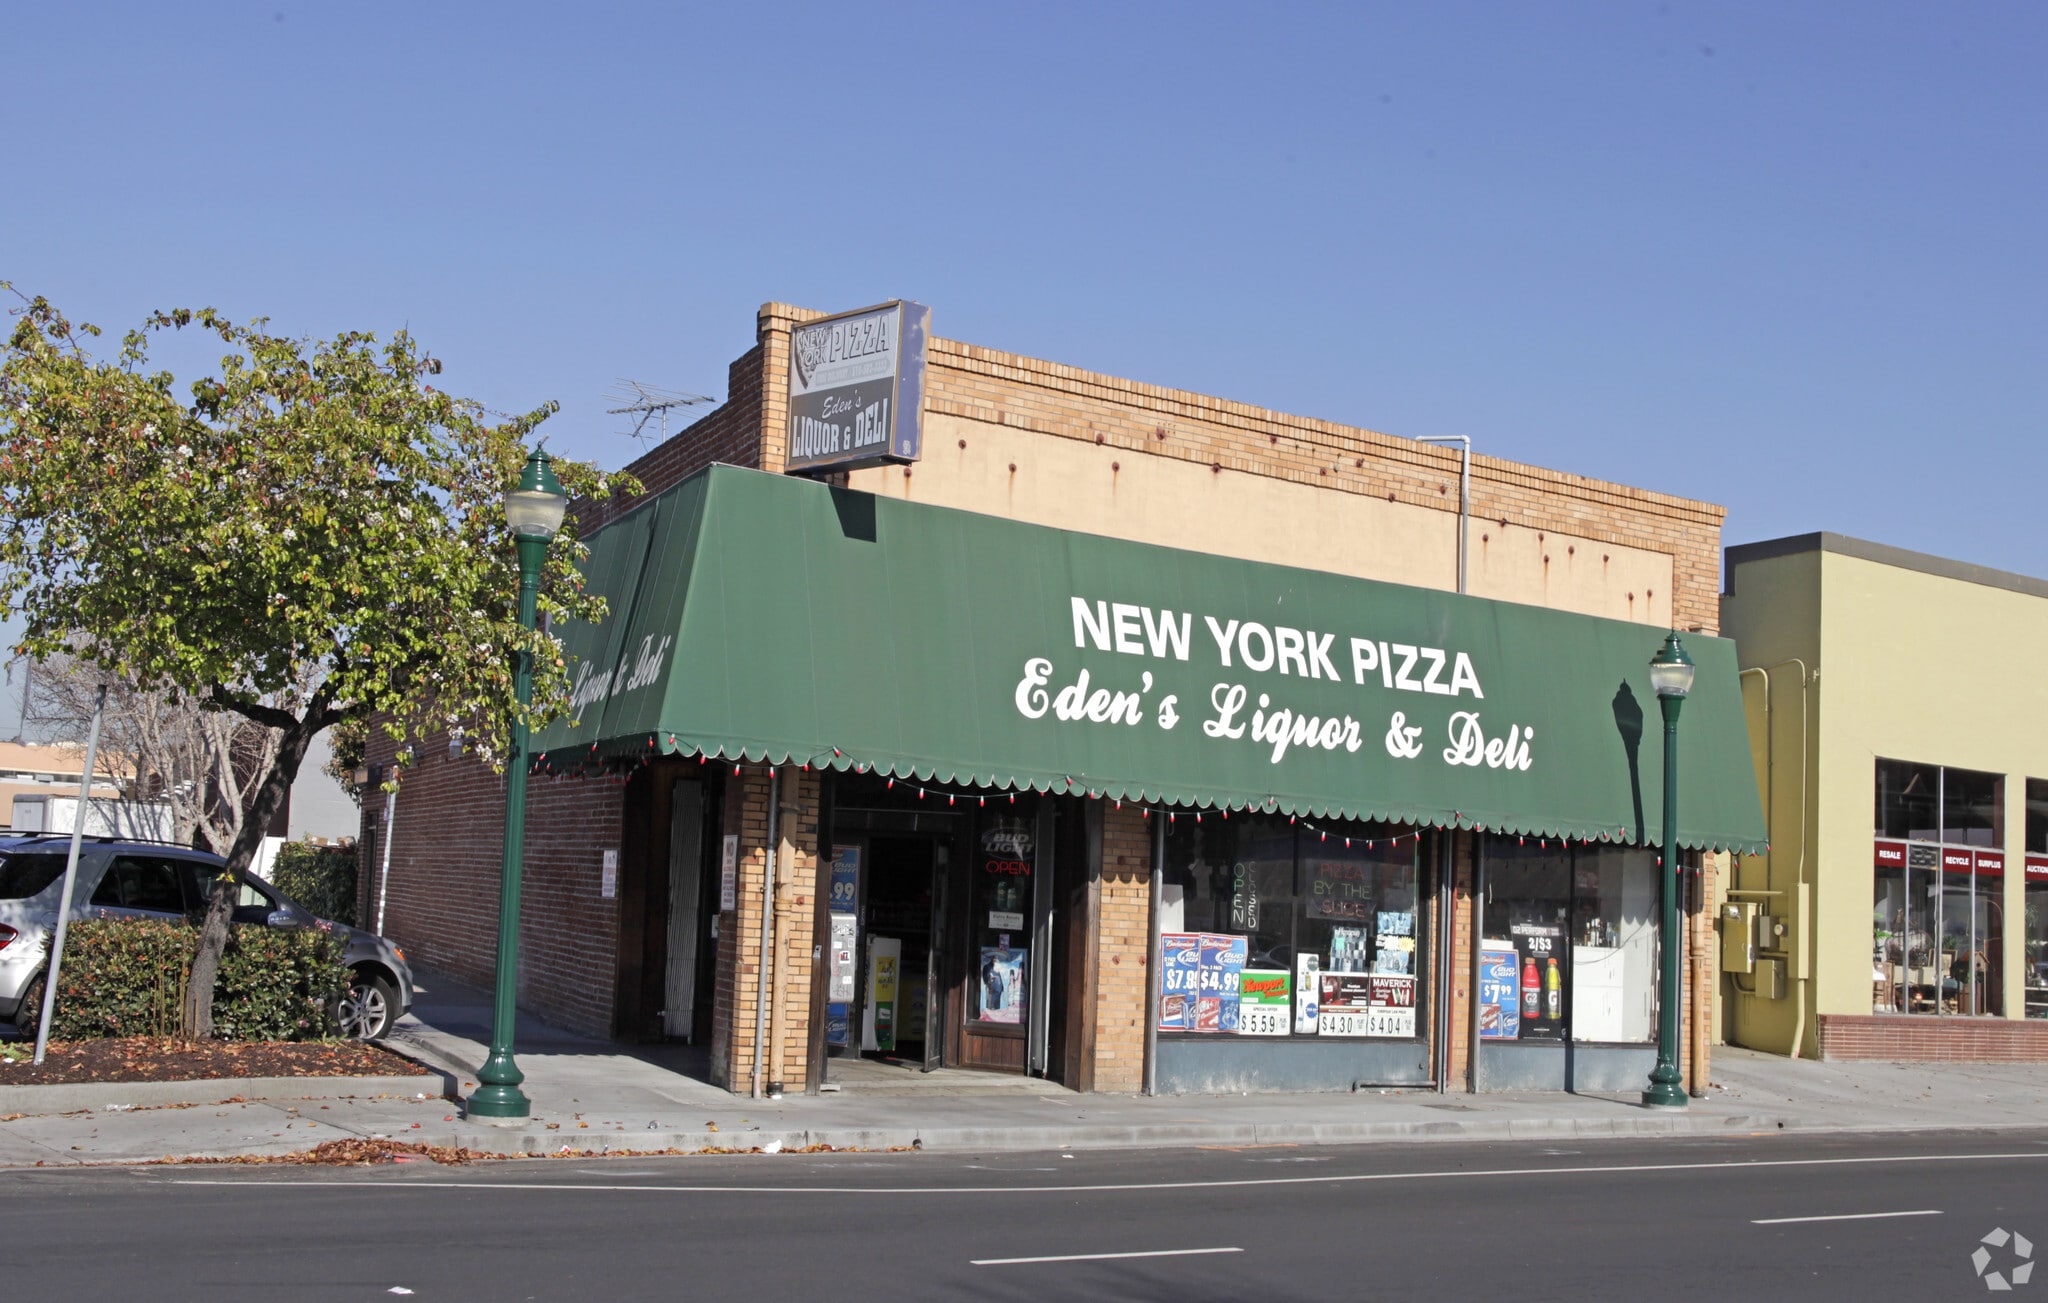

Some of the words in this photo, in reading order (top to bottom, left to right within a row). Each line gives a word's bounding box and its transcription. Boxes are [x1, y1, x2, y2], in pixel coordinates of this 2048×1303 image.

[829, 314, 889, 362] PIZZA
[800, 346, 826, 367] YORK
[821, 389, 862, 419] Eden's
[791, 415, 839, 459] LIQUOR
[843, 426, 851, 450] &
[854, 398, 888, 448] DELI
[1071, 597, 1192, 661] NEW
[1204, 616, 1341, 682] YORK
[1350, 637, 1485, 699] PIZZA
[1015, 657, 1181, 730] Eden's
[1202, 682, 1363, 764] Liquor
[1385, 711, 1423, 759] &
[1442, 711, 1534, 771] Deli
[992, 833, 1030, 843] BUD
[985, 842, 1034, 853] LIGHT
[1879, 850, 1901, 860] RESALE
[985, 860, 1031, 876] OPEN
[1945, 856, 1969, 866] RECYCLE
[1977, 859, 2001, 869] SURPLUS
[1320, 863, 1364, 880] PIZZA
[1232, 862, 1245, 924] OPEN
[1247, 861, 1257, 928] CLOSED
[1313, 879, 1335, 895] BY
[1341, 882, 1372, 899] THE
[1322, 899, 1365, 918] SLICE
[1528, 937, 1552, 951] 2/$3
[1201, 970, 1240, 991] $4.99
[1243, 977, 1285, 993] Newport
[1373, 978, 1411, 988] MAVERICK
[1525, 992, 1537, 1003] G2
[1548, 991, 1558, 1006] G
